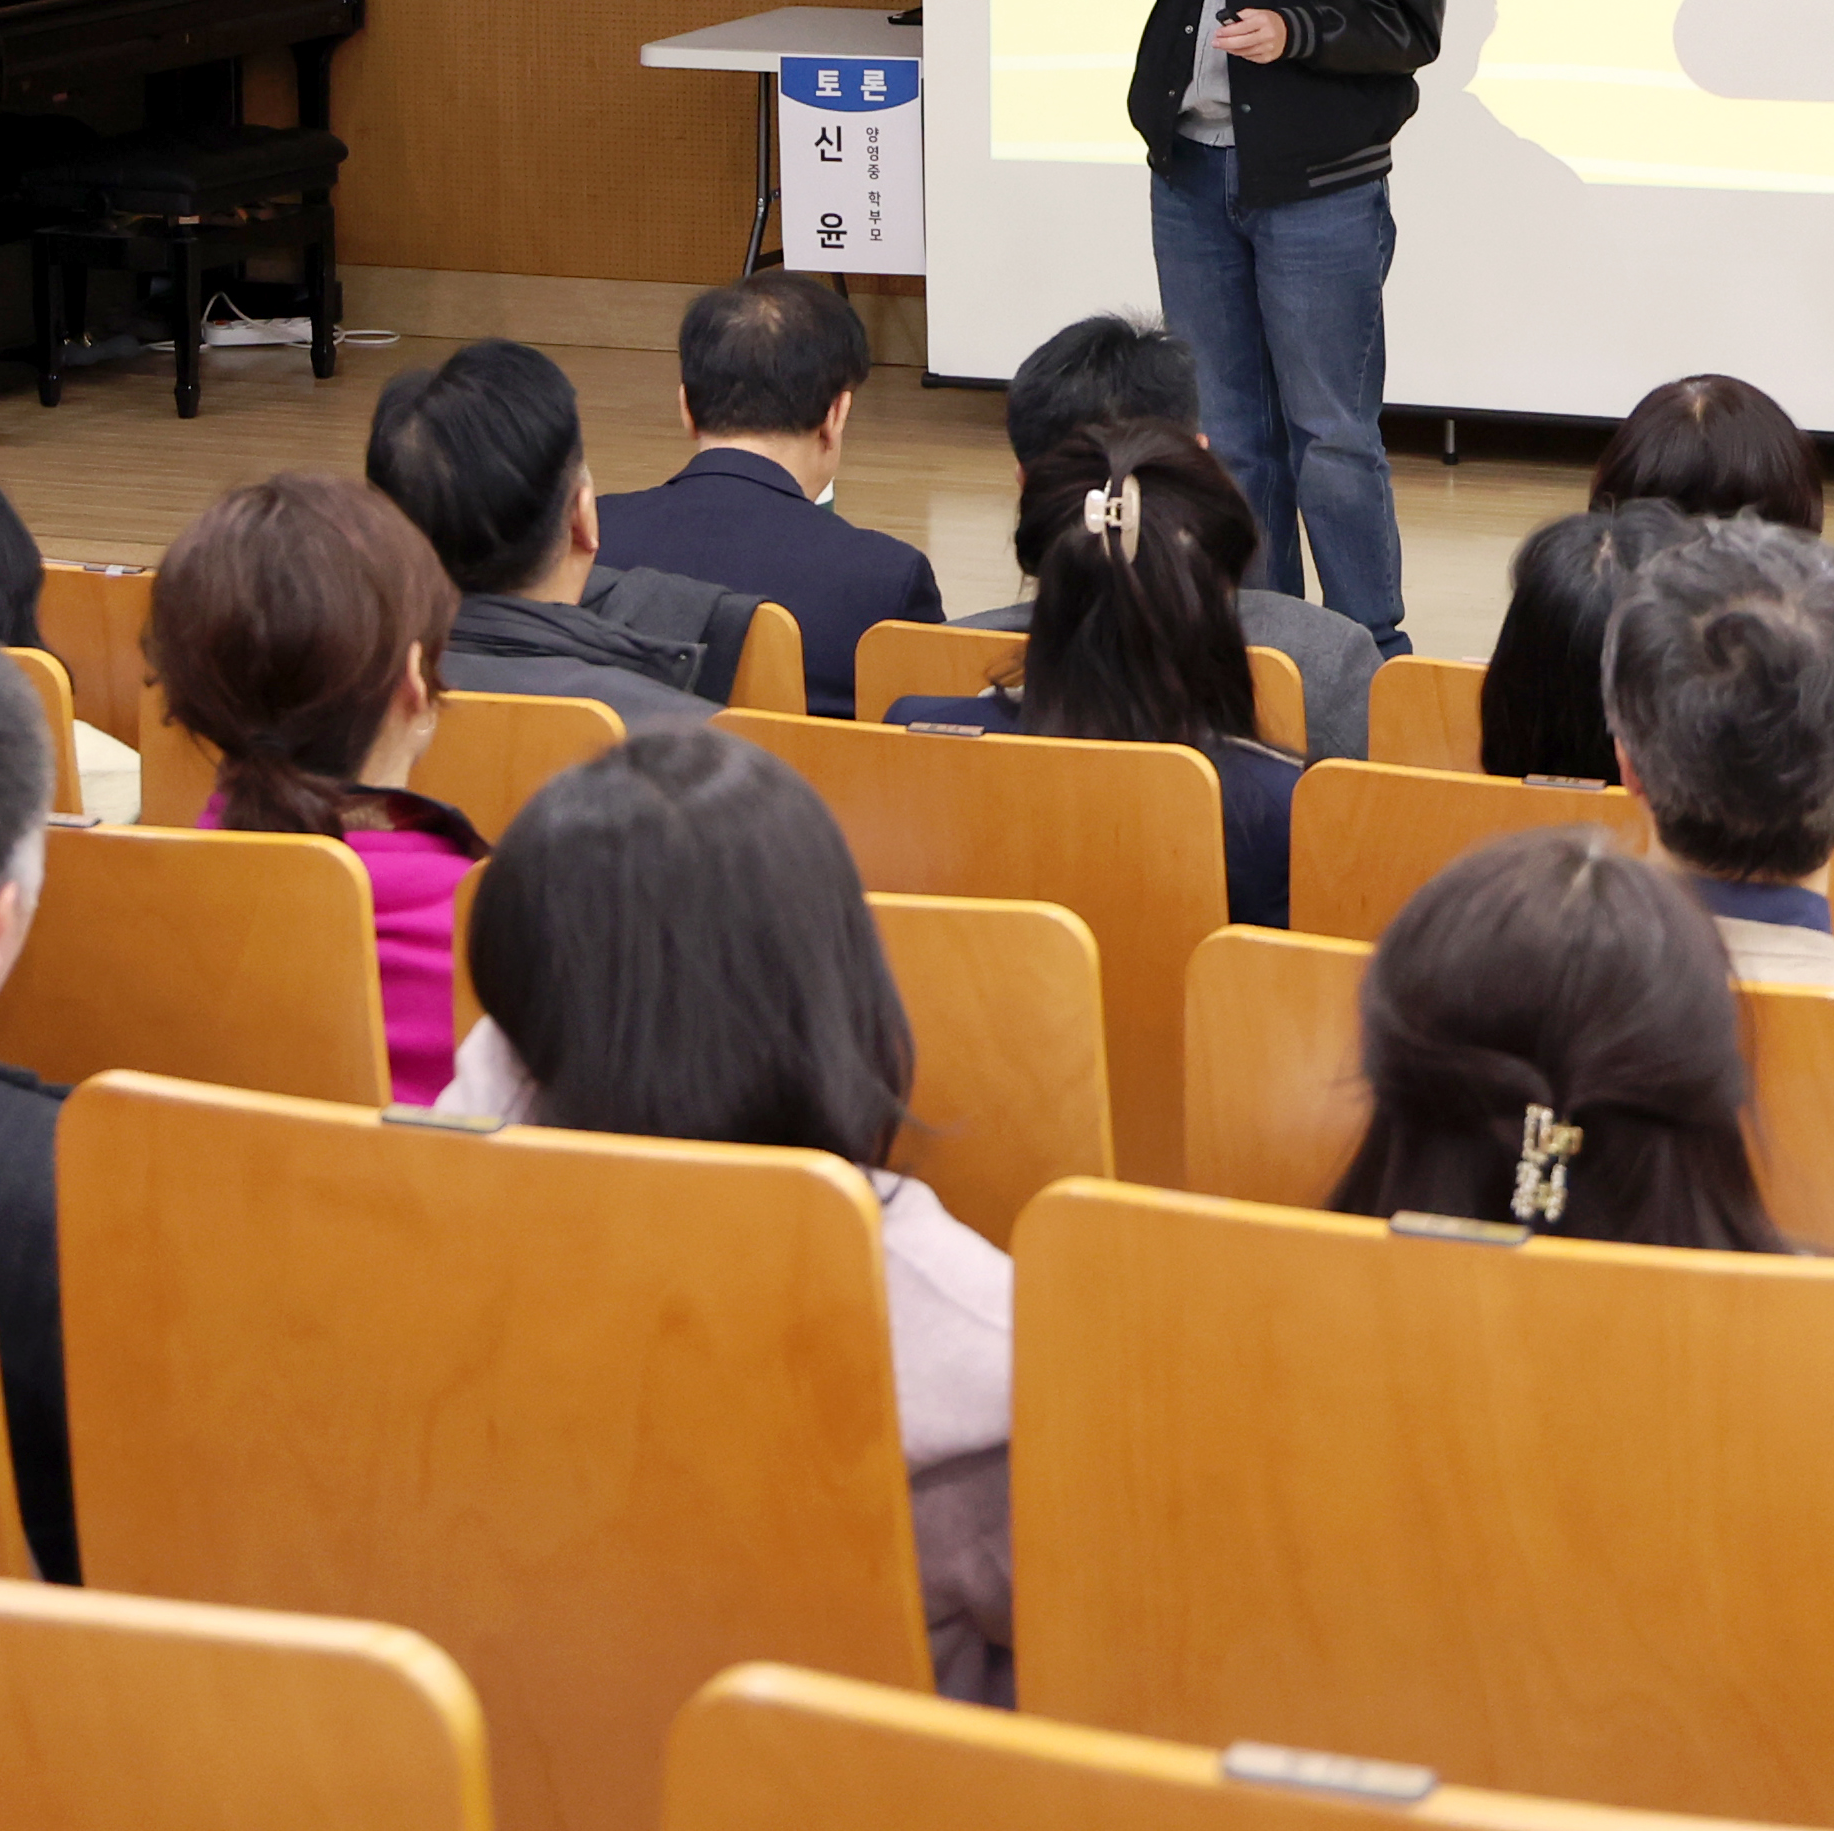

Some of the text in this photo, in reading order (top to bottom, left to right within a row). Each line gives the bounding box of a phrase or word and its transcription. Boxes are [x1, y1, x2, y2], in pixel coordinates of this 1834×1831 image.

[815, 68, 888, 102] 토론
[865, 126, 883, 242] 양영중 학부모
